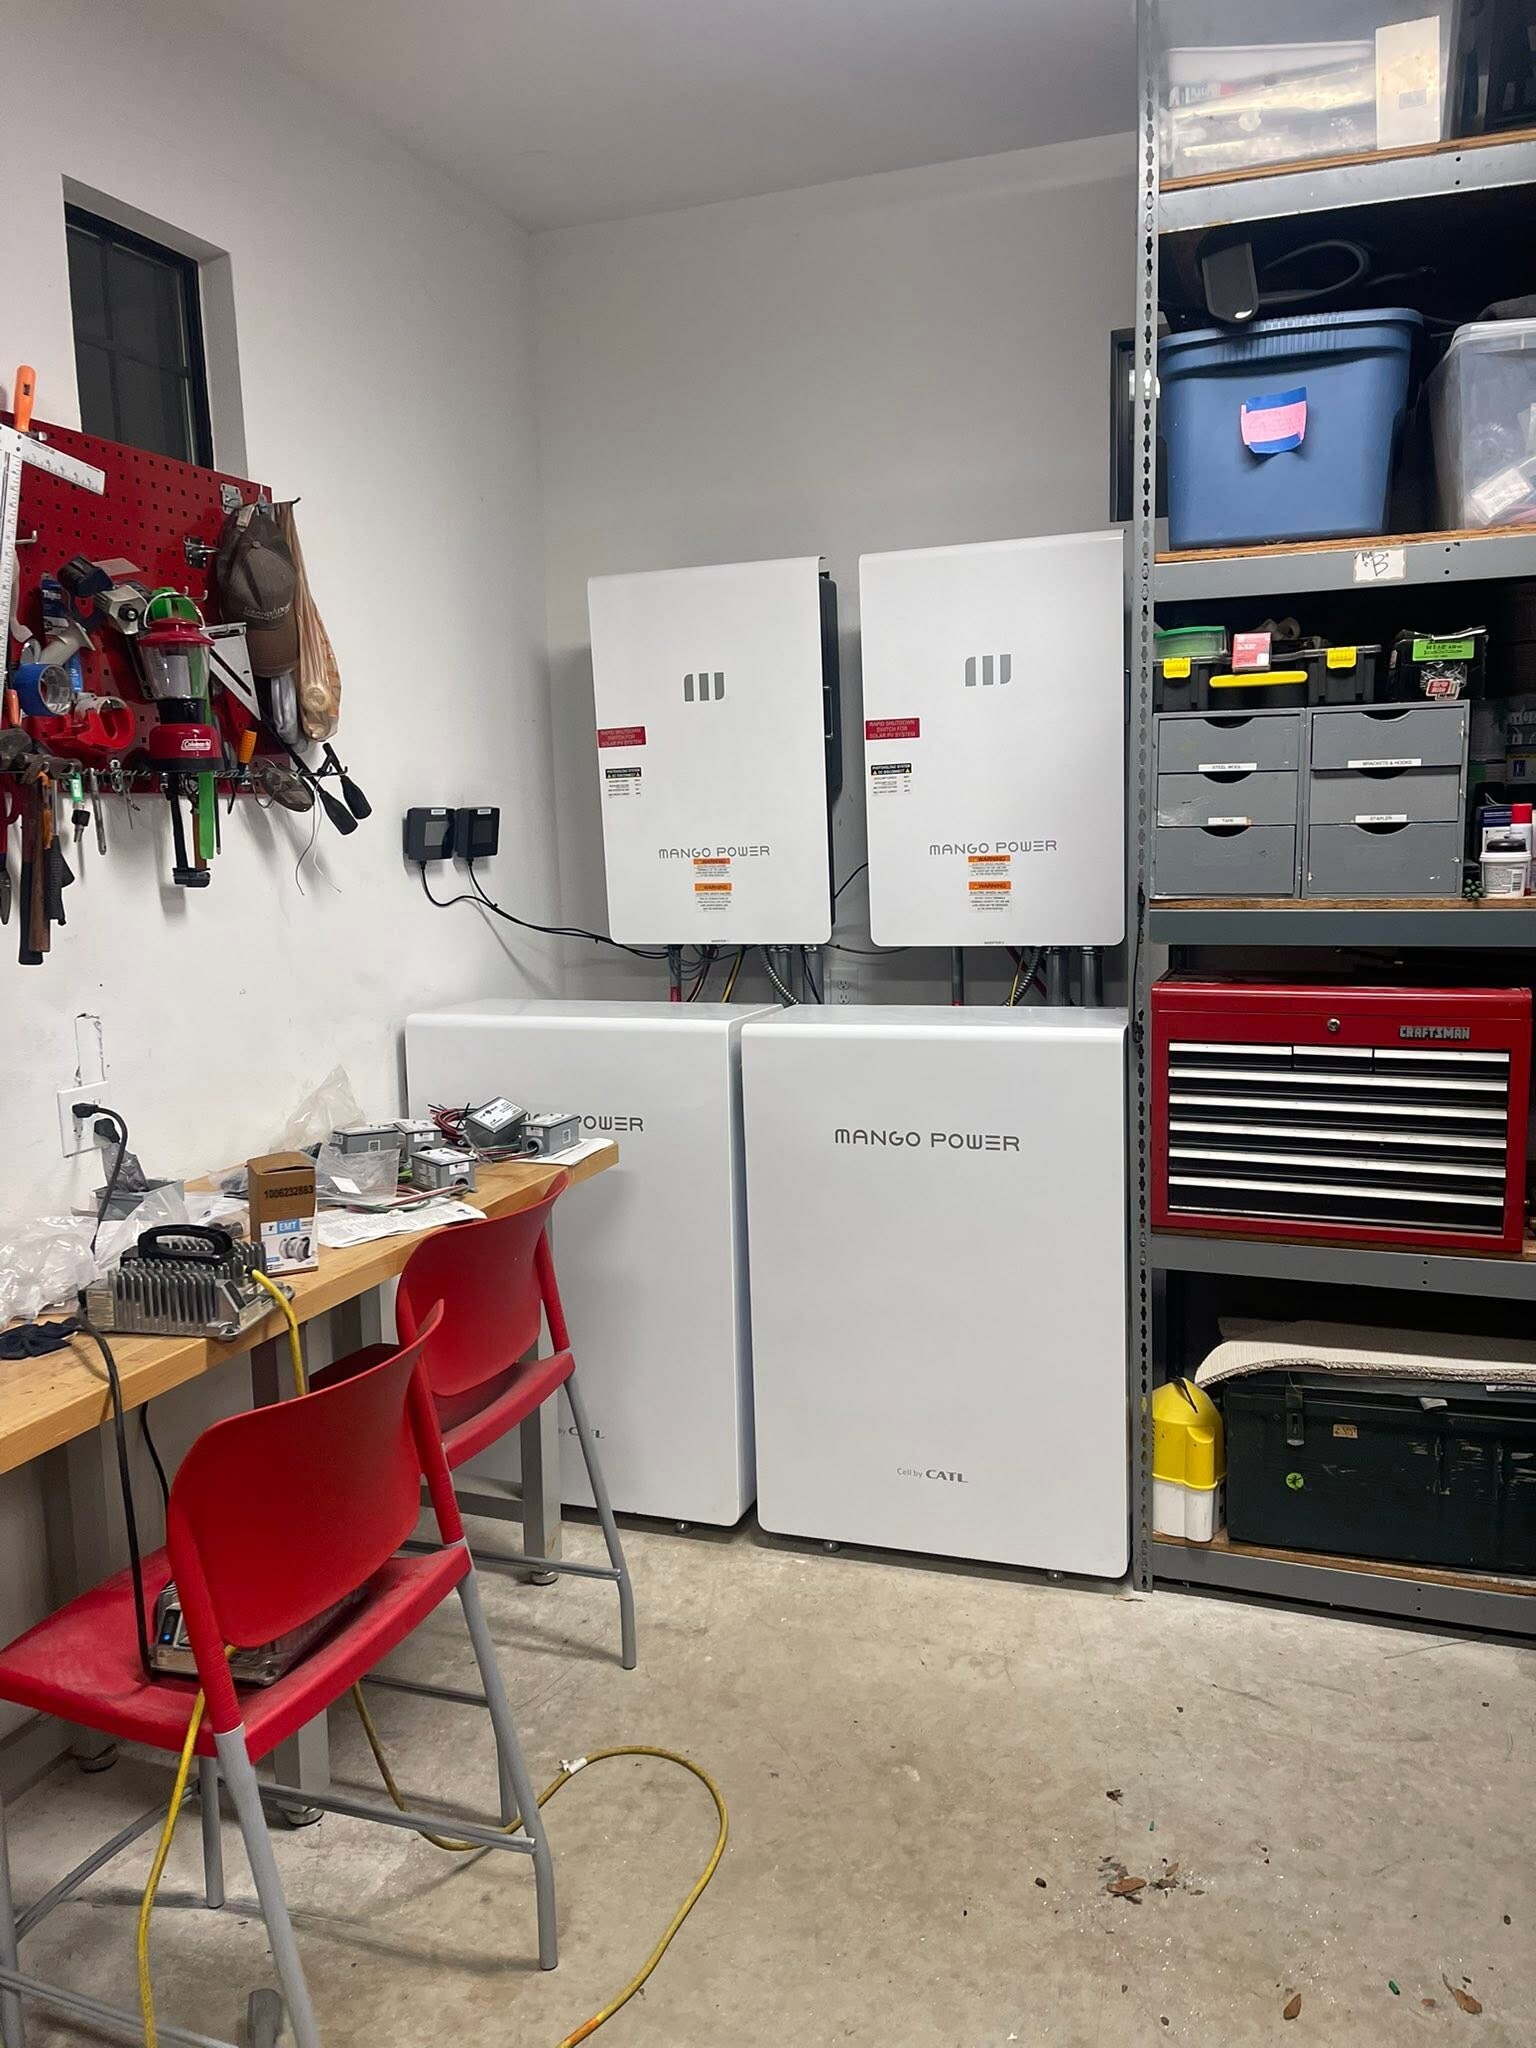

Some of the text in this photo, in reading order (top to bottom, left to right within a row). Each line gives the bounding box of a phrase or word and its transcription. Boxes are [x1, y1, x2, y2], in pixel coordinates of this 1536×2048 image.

[659, 845, 770, 859] MANGO POWER
[930, 840, 1057, 855] MANGO POWER
[1400, 1025, 1470, 1040] CRAFTSMAN
[835, 1128, 1020, 1152] MANGO POWER
[279, 1221, 297, 1232] EMT
[896, 1467, 968, 1484] Cell by CATL
